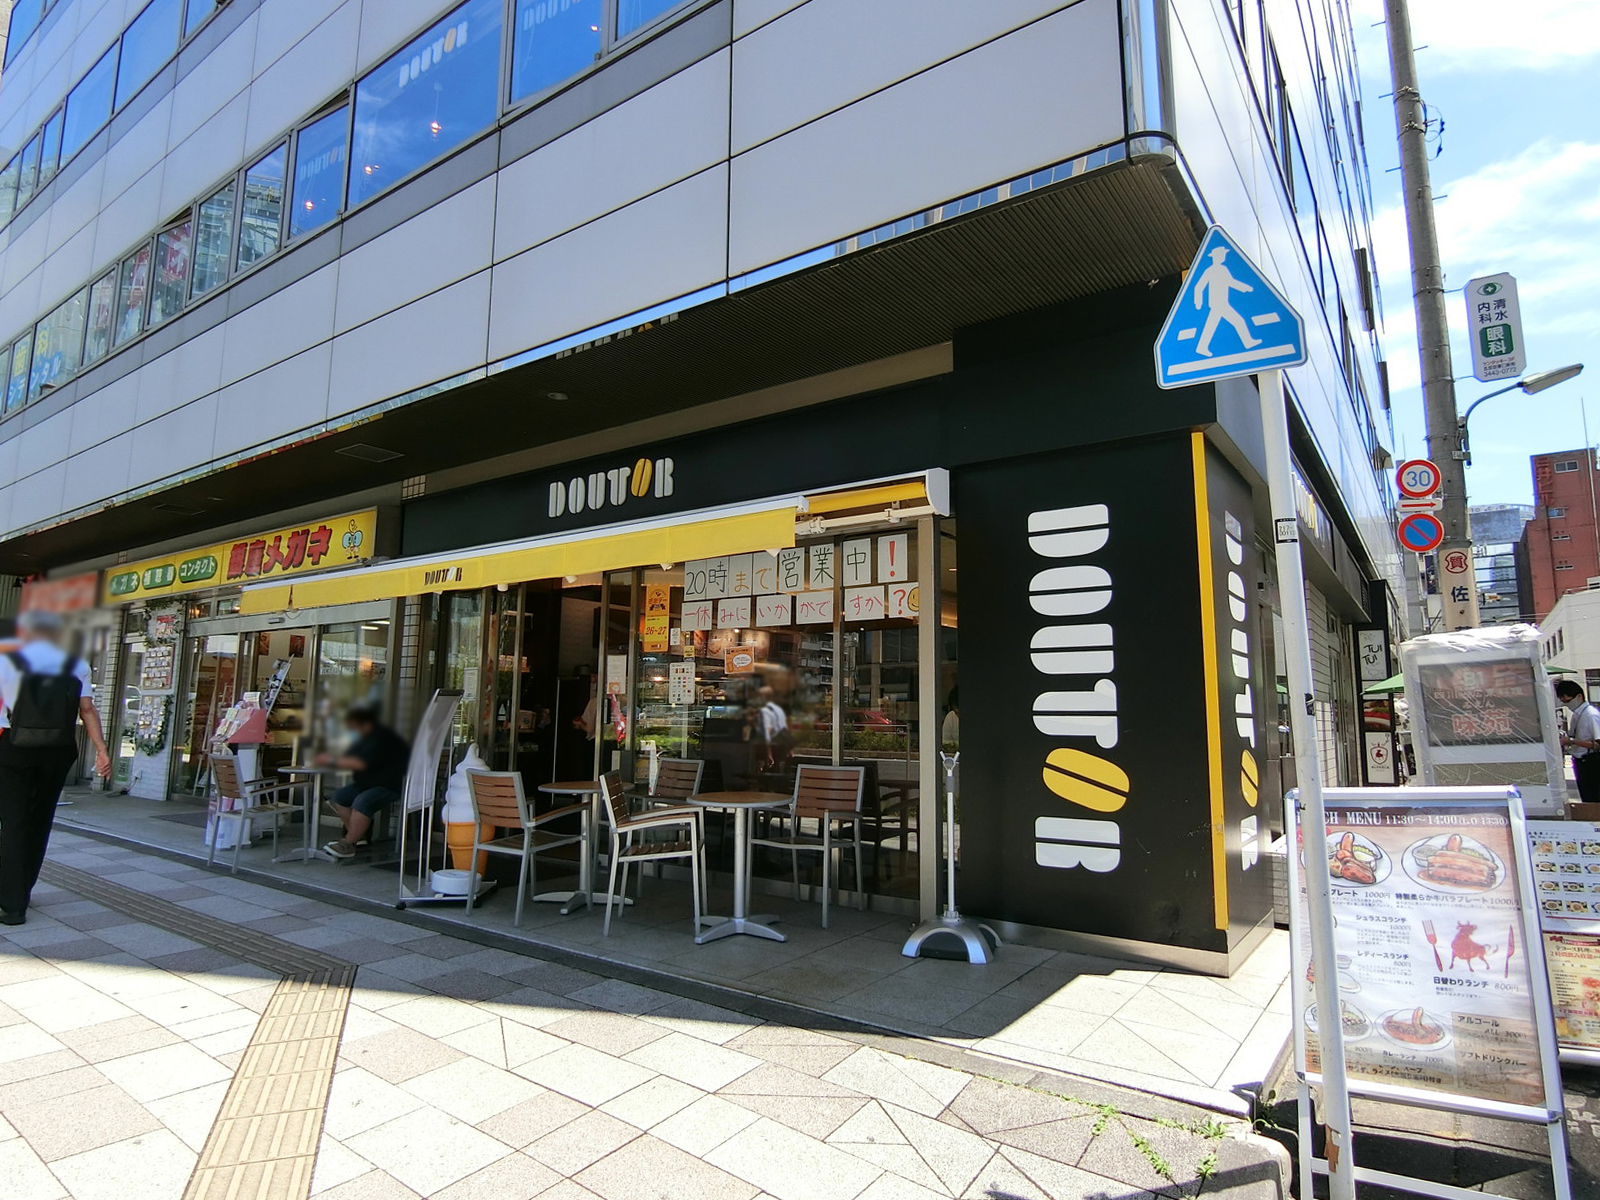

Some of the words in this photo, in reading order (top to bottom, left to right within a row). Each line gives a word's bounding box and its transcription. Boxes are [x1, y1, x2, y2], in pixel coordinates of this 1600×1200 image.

[1486, 326, 1507, 355] 眼科
[1406, 470, 1431, 487] 30
[548, 457, 675, 518] DOUTOR
[180, 556, 215, 577] コンタクト
[1449, 555, 1464, 570] 質
[424, 565, 463, 586] DOUTOR
[1363, 644, 1383, 654] TUI
[1362, 654, 1378, 664] TUI
[1027, 503, 1130, 873] DOUTOR
[1224, 510, 1259, 871] DOUTOR
[1346, 811, 1382, 825] MENU
[1433, 976, 1489, 988] 日替わりランチ
[1457, 1015, 1500, 1028] アルコール
